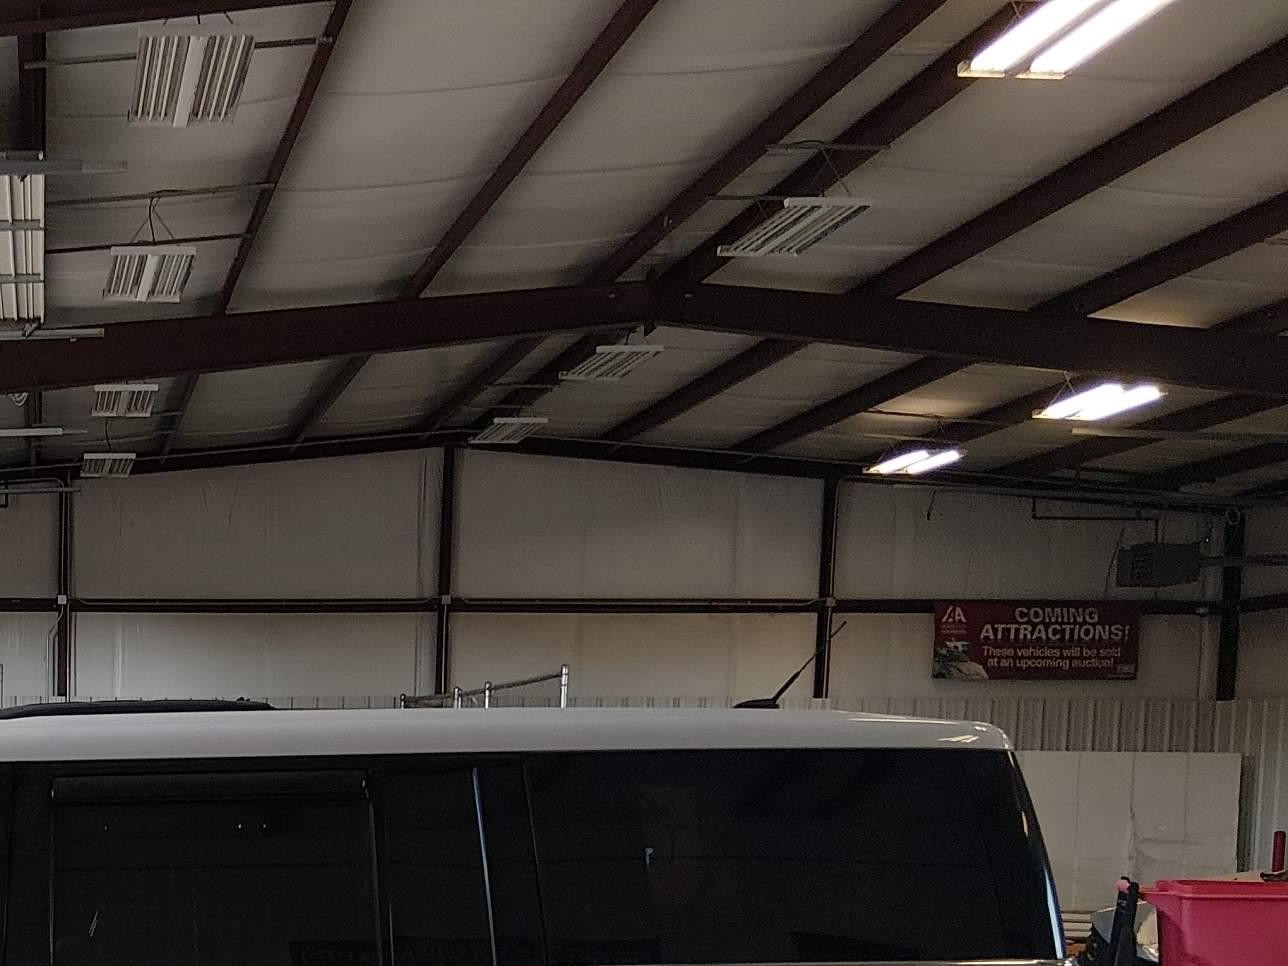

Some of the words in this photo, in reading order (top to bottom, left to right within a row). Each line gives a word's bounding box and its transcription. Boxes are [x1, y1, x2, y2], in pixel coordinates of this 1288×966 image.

[1015, 607, 1099, 623] COMING
[979, 624, 1130, 641] ATTRACTIONS!
[983, 646, 1014, 657] These
[1016, 646, 1060, 657] vehicles
[1062, 646, 1080, 657] will
[1083, 646, 1096, 657] be
[1098, 646, 1121, 657] sold
[987, 658, 998, 668] at
[1000, 659, 1014, 668] an
[1016, 658, 1069, 671] upcoming
[1071, 658, 1114, 669] auction!
